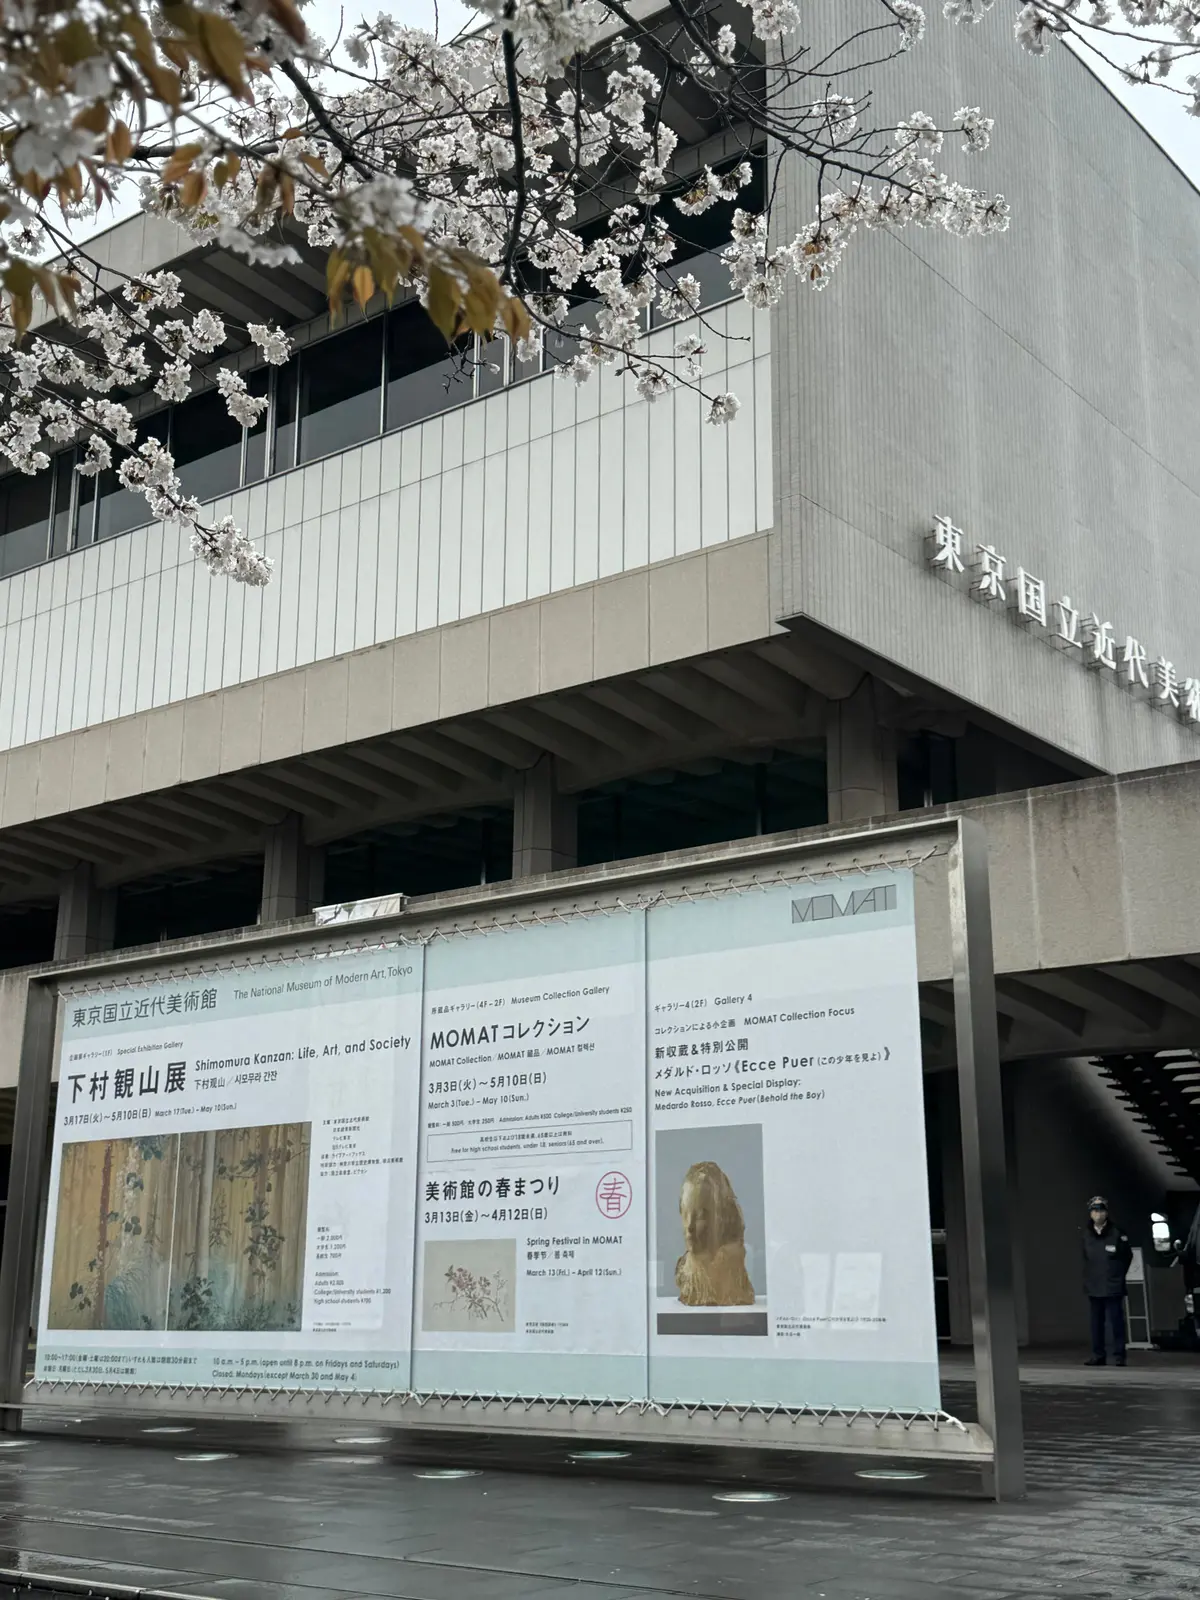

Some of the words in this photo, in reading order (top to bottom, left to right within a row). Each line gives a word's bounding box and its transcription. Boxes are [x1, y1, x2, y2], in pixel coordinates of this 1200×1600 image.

[233, 989, 249, 1000] The
[250, 984, 284, 998] National
[286, 979, 322, 992] Museum
[323, 975, 333, 986] of
[335, 972, 369, 985] Modern
[370, 969, 387, 980] Art,
[387, 965, 413, 978] Tokyo
[511, 995, 540, 1005] Museum
[542, 990, 580, 1001] Collection
[582, 986, 610, 996] Gallery
[714, 996, 745, 1006] Gallery
[72, 988, 218, 1028] 東京国立近代美術館
[655, 1019, 735, 1035] コレクションによる小企画
[744, 1014, 777, 1026] MOMAT
[780, 1010, 825, 1022] Collection
[828, 1008, 855, 1017] Focus
[430, 1015, 590, 1050] MOMATコレクション
[117, 1046, 137, 1057] Special
[137, 1043, 162, 1054] Exhibition
[163, 1041, 184, 1051] Gallery
[195, 1056, 251, 1072] Shimomura
[254, 1051, 294, 1065] Kanzan:
[298, 1046, 319, 1059] Life,
[323, 1043, 341, 1056] Art,
[345, 1040, 366, 1054] and
[369, 1035, 411, 1051] Society
[429, 1058, 455, 1068] MOMAT
[577, 1042, 595, 1052] 컬렉션
[655, 1038, 749, 1059] 新収蔵&特別公開
[782, 1055, 814, 1069] Puer
[68, 1061, 187, 1104] 下村観山展
[263, 1070, 278, 1082] 간잔
[654, 1089, 672, 1098] New
[675, 1083, 720, 1096] Acquisition
[723, 1083, 729, 1091] &
[731, 1080, 764, 1092] Special
[766, 1078, 801, 1089] Display:
[428, 1100, 449, 1109] March
[482, 1096, 498, 1106] May
[654, 1102, 688, 1111] Medardo
[690, 1100, 715, 1109] Rosso,
[716, 1098, 736, 1106] Ecce
[790, 1092, 803, 1100] the
[806, 1089, 825, 1100] Boy)
[200, 1106, 213, 1114] May
[554, 1109, 598, 1119] College/University
[599, 1107, 619, 1115] students
[470, 1145, 481, 1153] high
[425, 1176, 560, 1201] 美術館の春まつり
[526, 1237, 550, 1247] Spring
[552, 1236, 581, 1246] Festival
[582, 1236, 590, 1245] in
[592, 1236, 623, 1245] MOMAT
[577, 1269, 593, 1277] April
[213, 1357, 220, 1365] 10
[325, 1360, 348, 1370] Fridays
[350, 1360, 363, 1368] and
[364, 1360, 400, 1370] Saturdays)
[289, 1372, 310, 1380] March
[311, 1372, 319, 1380] 30
[335, 1373, 349, 1382] May
